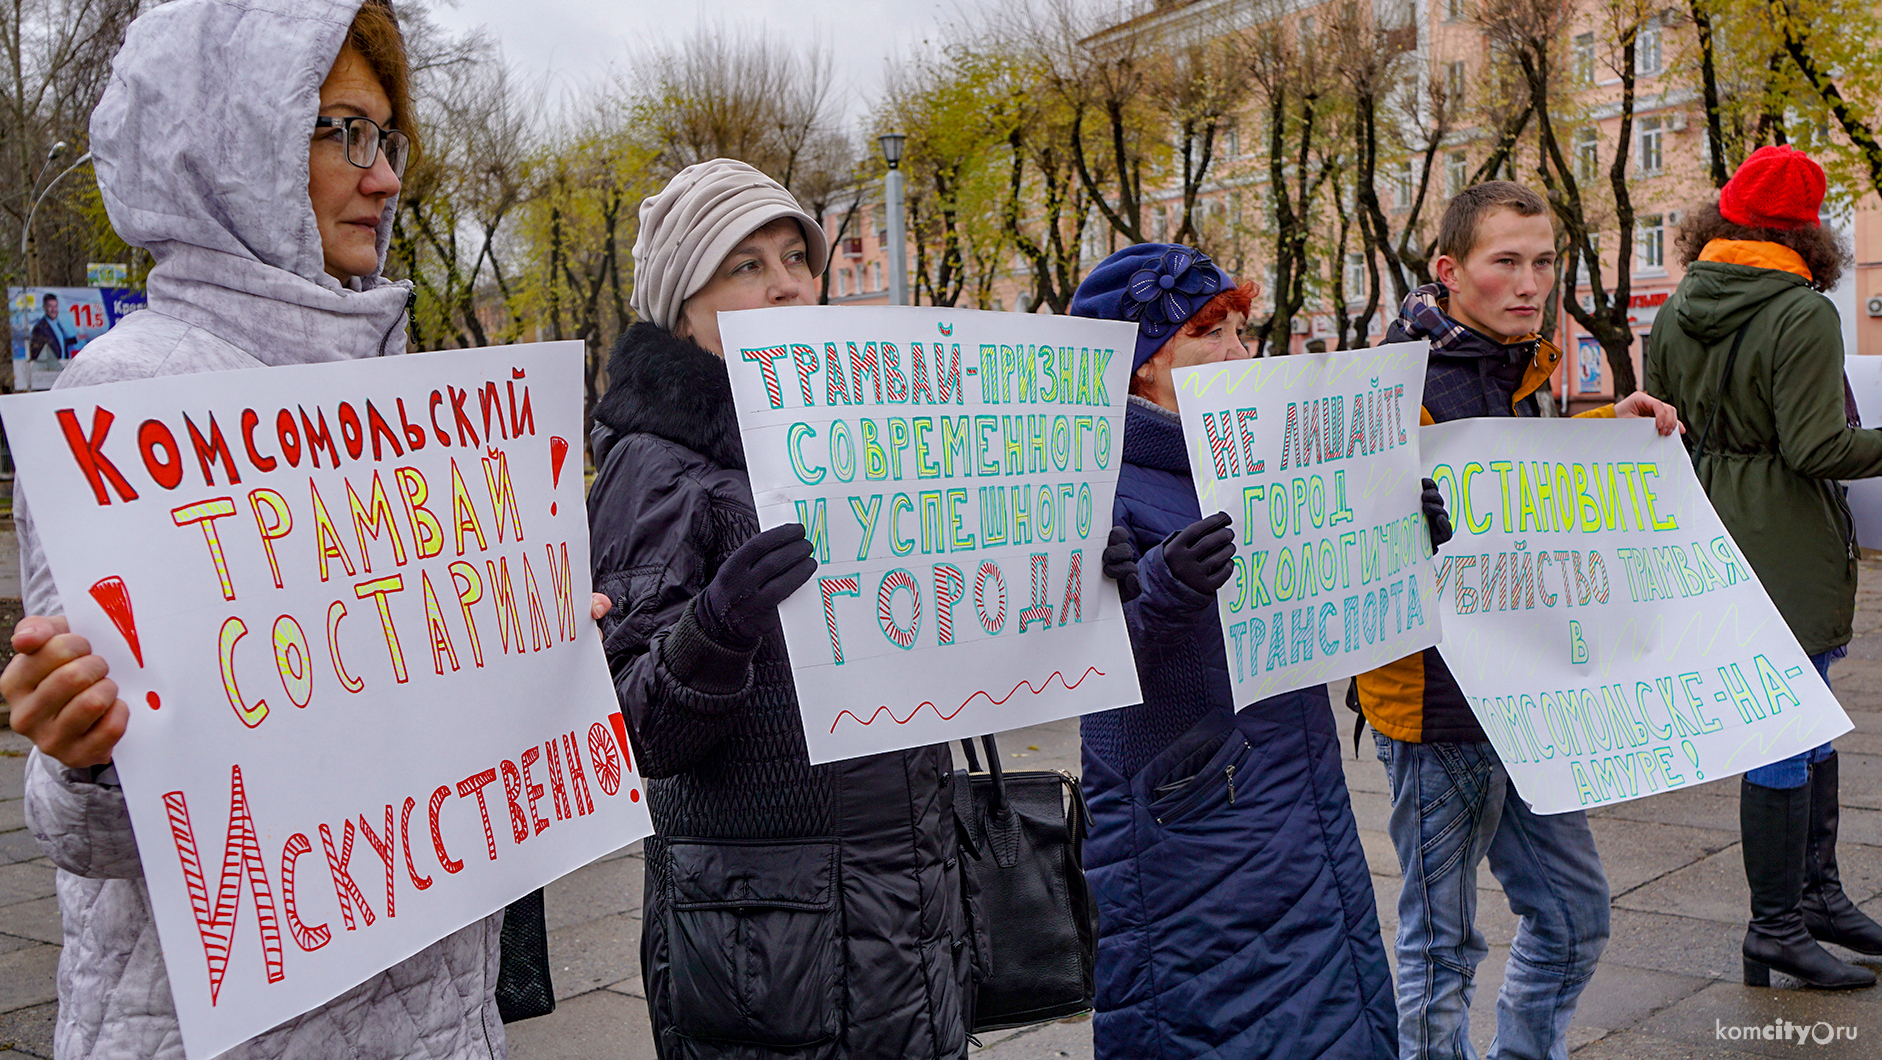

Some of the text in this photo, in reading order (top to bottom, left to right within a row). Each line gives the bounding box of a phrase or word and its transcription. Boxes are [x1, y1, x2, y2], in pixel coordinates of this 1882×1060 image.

[54, 367, 536, 506] КОМСОМОЛЬСКИЙ
[786, 415, 1111, 486] СОВРЕМЕННОГО
[1203, 376, 1408, 480] НЕ ЛИШАЙТЕ
[171, 447, 523, 601] ТРАМВАЙ
[794, 482, 1092, 565] И УСПЕШНОГО
[1242, 470, 1353, 546] ГОРОД
[1431, 460, 1679, 535] ОСТАНОВИТЕ
[818, 549, 1083, 666] ГОРОДА
[1229, 511, 1432, 613] ЭКОЛОГИЧНОГО
[1433, 536, 1750, 615] УБИЙСТВО ТРАМВАЯ
[217, 541, 576, 729] СОСТАРИЛИ
[1229, 574, 1424, 684] ТРАНСПОРТА
[1568, 619, 1589, 664] В
[1570, 739, 1705, 805] АМУРЕ!
